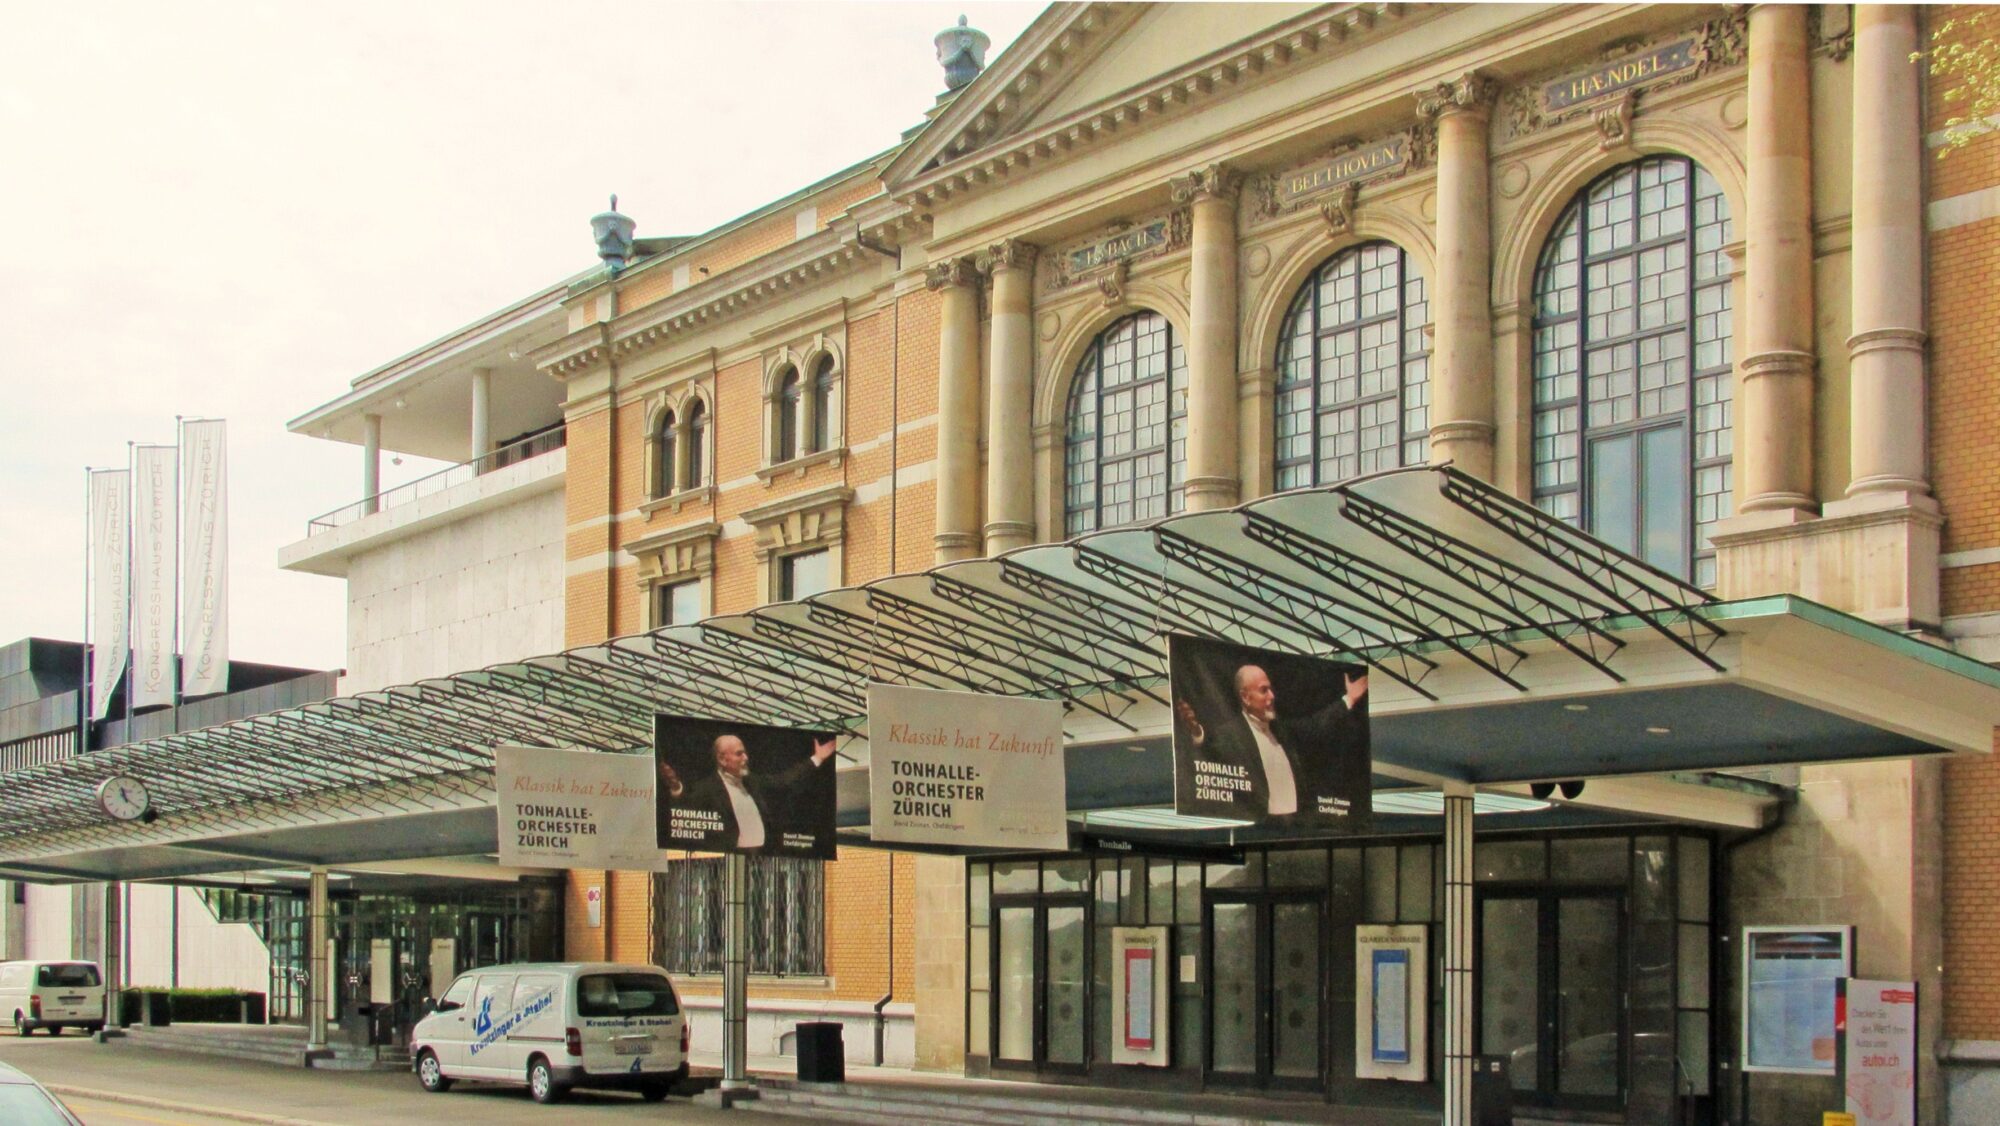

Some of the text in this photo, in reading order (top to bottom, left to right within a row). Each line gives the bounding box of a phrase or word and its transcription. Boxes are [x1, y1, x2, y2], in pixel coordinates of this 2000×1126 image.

[1292, 144, 1397, 194] BEETHOVEN
[196, 438, 215, 681] KONGRESSHAUS ZÜRICH
[144, 463, 163, 693] KONGRESSHAUS ZÜRICH
[889, 723, 1057, 760] Klassik hat Zukunft
[891, 760, 980, 781] TONHALLE-
[1194, 760, 1249, 778] TONHALLE-
[513, 775, 565, 794] Klassik
[571, 779, 594, 796] hat
[892, 780, 984, 801] ORCHESTER
[1195, 774, 1252, 792] ORCHESTER
[1196, 786, 1234, 803] ZÜRICH
[516, 804, 593, 820] TONHALLE-
[670, 808, 721, 821] TONHALLE-
[893, 797, 951, 818] ZÜRICH
[517, 820, 597, 835] ORCHESTER
[671, 819, 724, 831] ORCHESTER
[671, 828, 705, 840] ZÜRICH
[518, 832, 568, 848] ZÜRICH
[1098, 839, 1132, 850] Tonhalle
